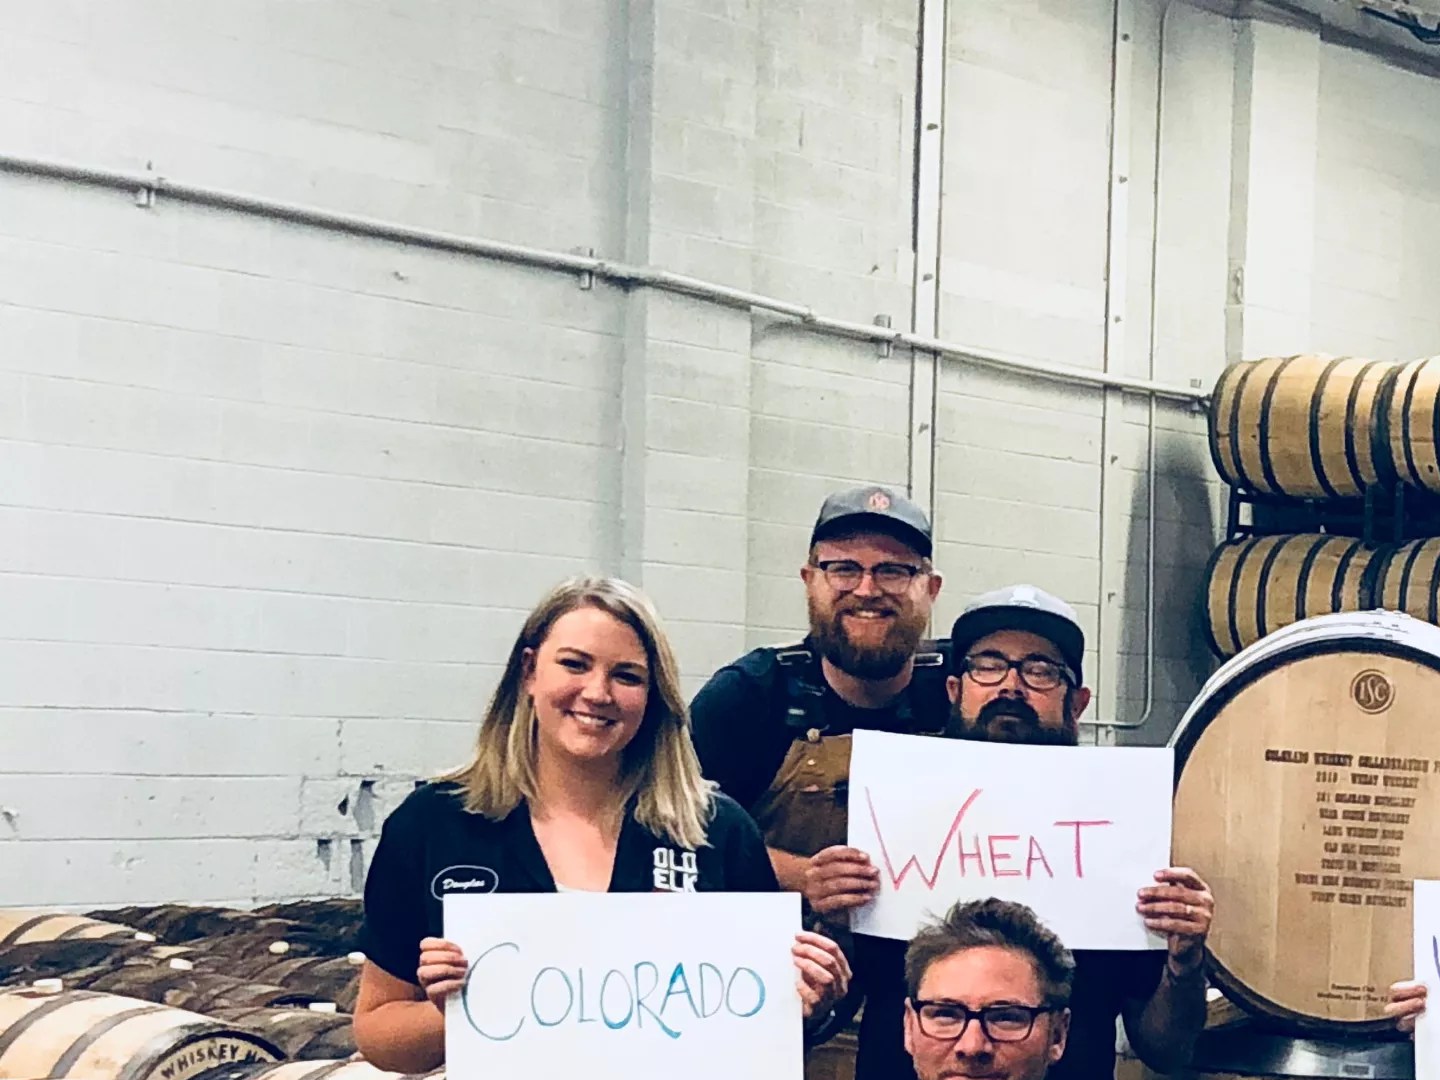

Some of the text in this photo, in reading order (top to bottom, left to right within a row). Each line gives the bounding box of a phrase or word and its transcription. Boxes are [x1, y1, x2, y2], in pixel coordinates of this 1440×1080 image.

[864, 786, 1113, 890] WHEAT
[653, 847, 697, 872] OLD
[653, 870, 698, 892] ELK
[462, 942, 766, 1041] COLORADO
[161, 1043, 240, 1079] WHISKEY
